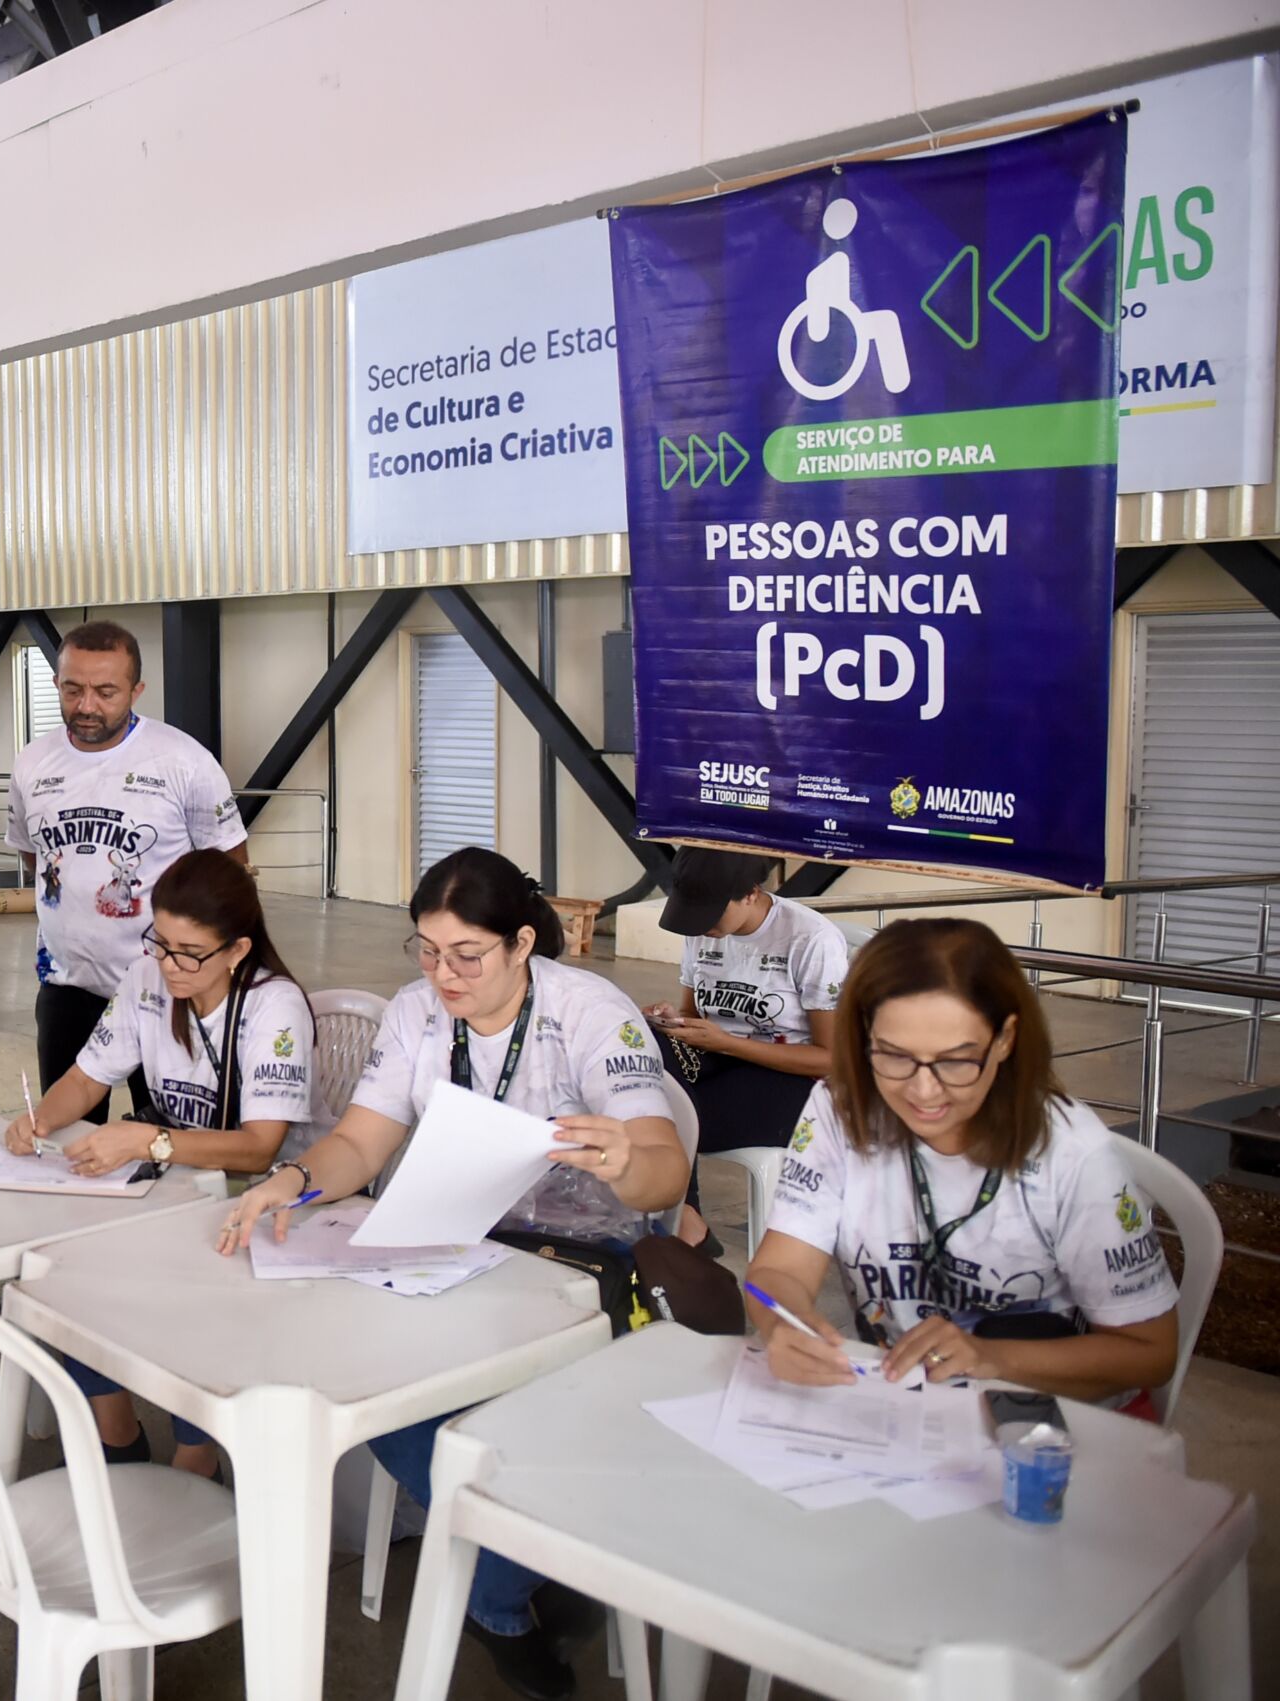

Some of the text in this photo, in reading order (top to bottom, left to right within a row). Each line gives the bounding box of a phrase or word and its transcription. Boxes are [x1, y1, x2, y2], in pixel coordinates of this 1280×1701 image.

[367, 345, 491, 391] Secretaria
[500, 337, 537, 369] de
[367, 391, 525, 435] de Cultura e
[368, 422, 613, 479] Economia Criativa
[796, 424, 903, 450] SERVIÇO DE
[797, 444, 996, 475] ATENDIMENTO PARA
[705, 514, 1008, 561] PESSOAS COM
[728, 566, 982, 615] DEFICIÊNCIA
[699, 761, 770, 788] SEJUSC
[823, 784, 850, 793] Direitos
[700, 788, 713, 800] EM
[715, 789, 737, 803] TODO
[797, 790, 829, 799] Humanos
[835, 793, 870, 803] Cidadania
[923, 785, 1016, 819] AMAZONAS
[76, 808, 106, 818] FESTIVAL
[107, 810, 117, 819] DE
[937, 813, 965, 821] GOVERNO
[975, 817, 998, 825] ESTADO
[41, 820, 141, 853] PARINTINS
[697, 988, 769, 1019] PARINTINS
[955, 1261, 970, 1274] DE
